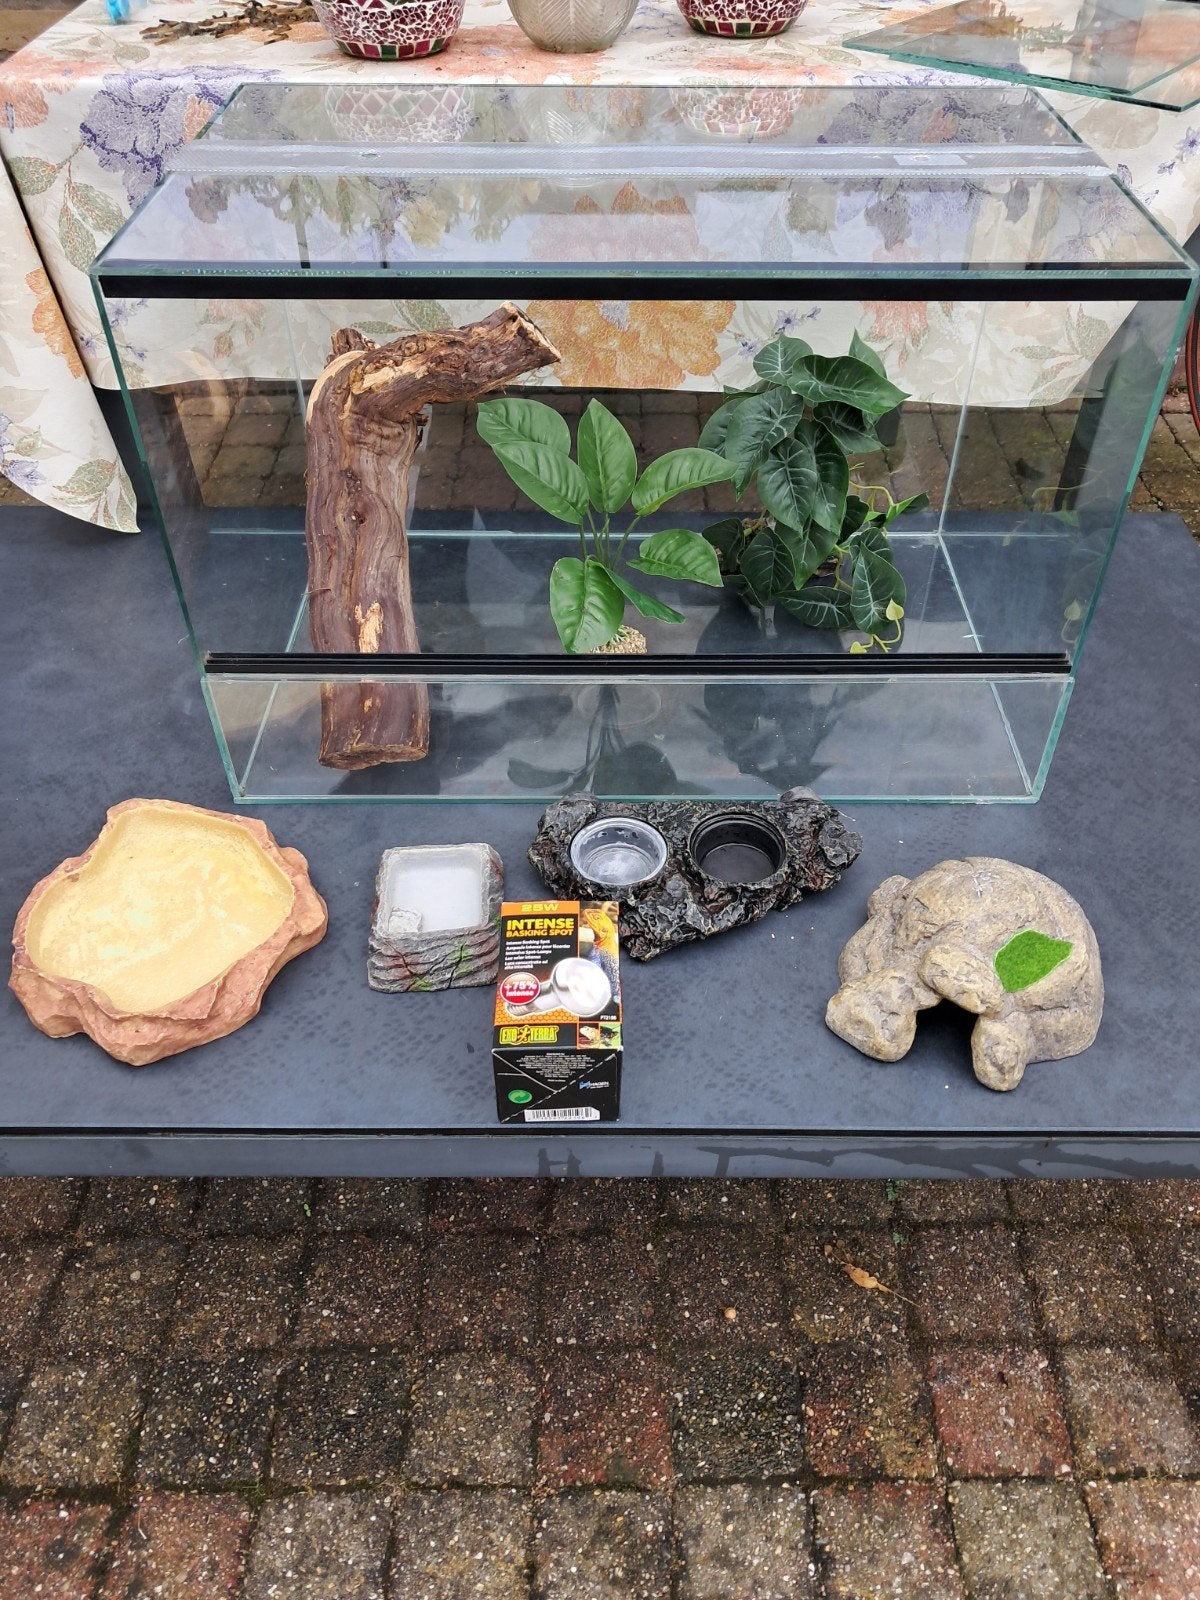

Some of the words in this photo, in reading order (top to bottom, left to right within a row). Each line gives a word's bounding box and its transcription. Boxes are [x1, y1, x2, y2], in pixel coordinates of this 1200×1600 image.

[521, 903, 559, 912] 25W
[506, 918, 575, 931] INTENSE
[506, 930, 547, 938] BASKING
[504, 980, 537, 990] +75%
[502, 1028, 518, 1042] EXO
[530, 1027, 557, 1041] TERRA
